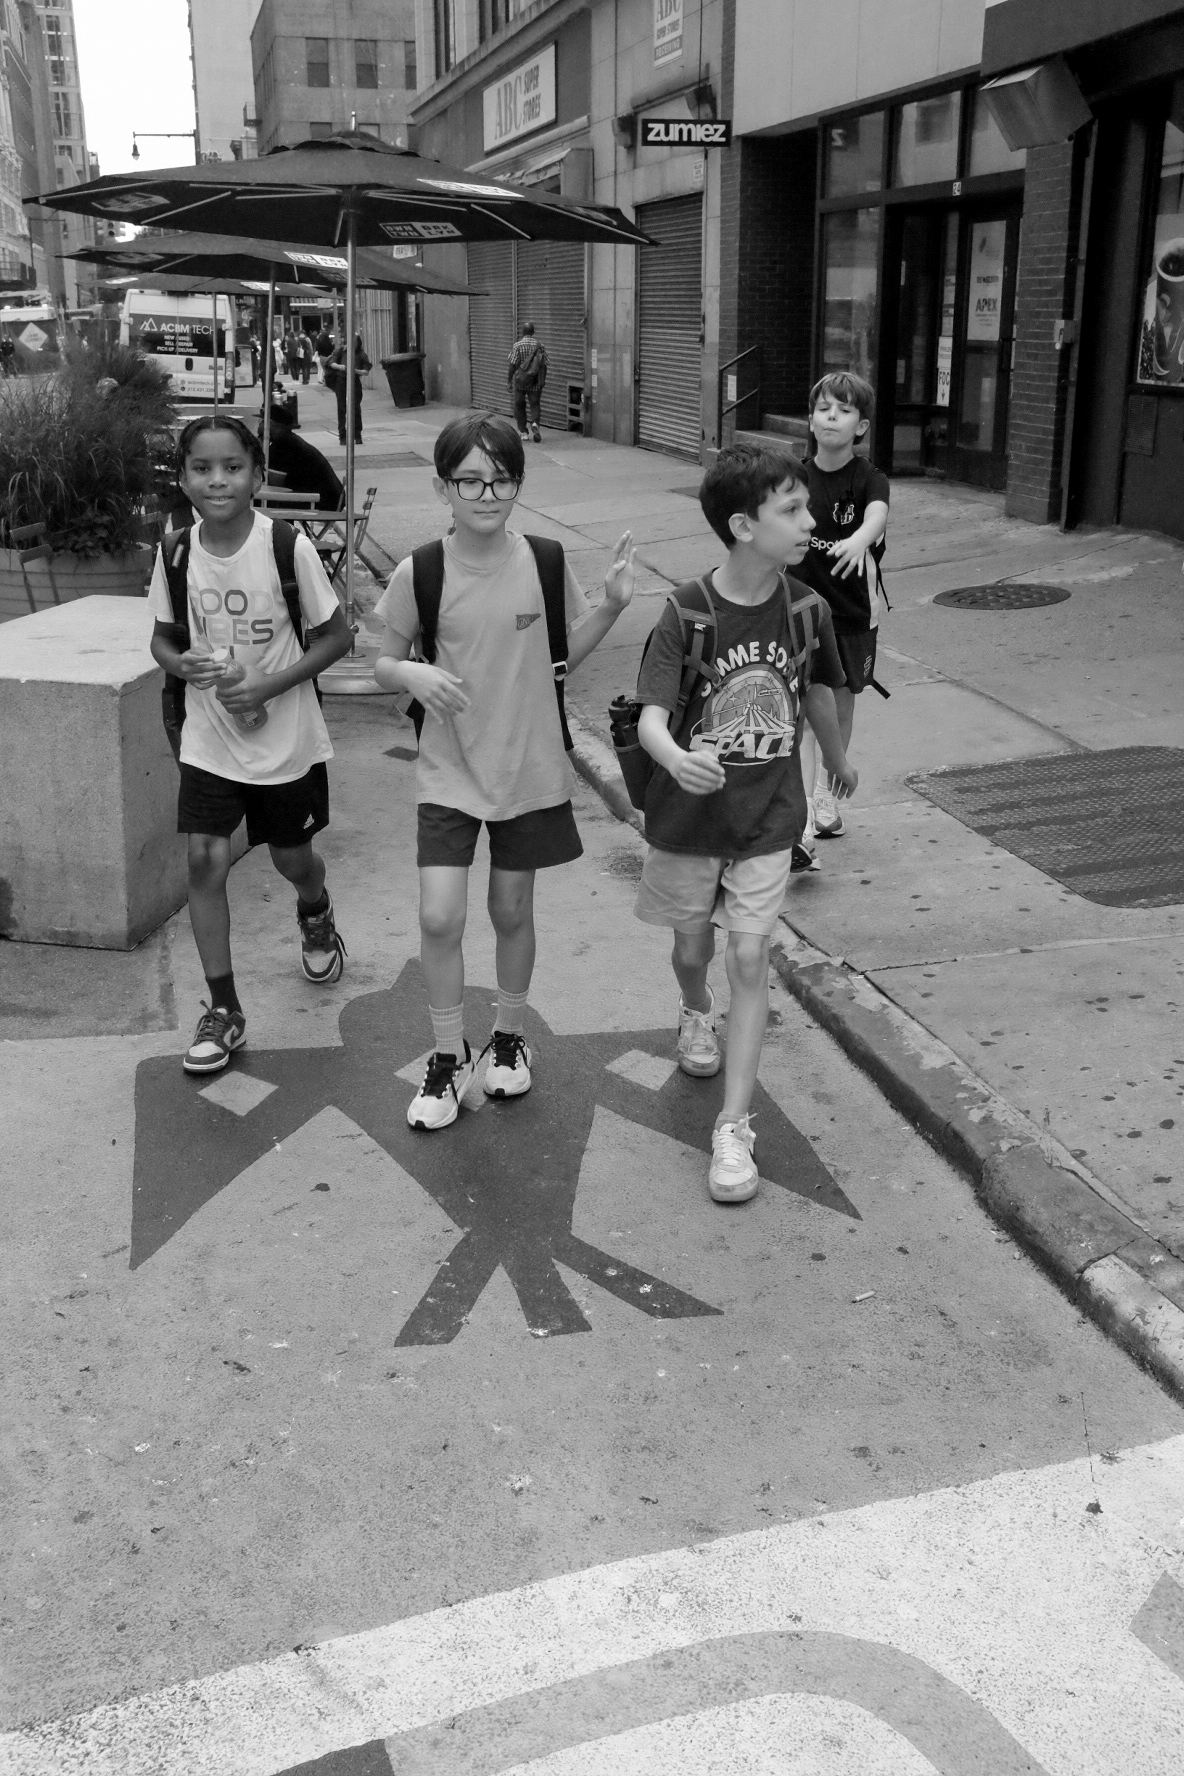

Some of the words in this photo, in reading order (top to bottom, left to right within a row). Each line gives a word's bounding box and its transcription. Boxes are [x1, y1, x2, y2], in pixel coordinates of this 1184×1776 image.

[656, 0, 681, 23] ABC
[523, 64, 540, 96] SUPER
[494, 75, 522, 140] ABC
[522, 93, 541, 126] STORES
[647, 123, 726, 142] zumiez
[953, 182, 961, 196] 24
[976, 298, 999, 312] APEX
[160, 323, 190, 333] ACBM
[192, 324, 214, 335] TECH
